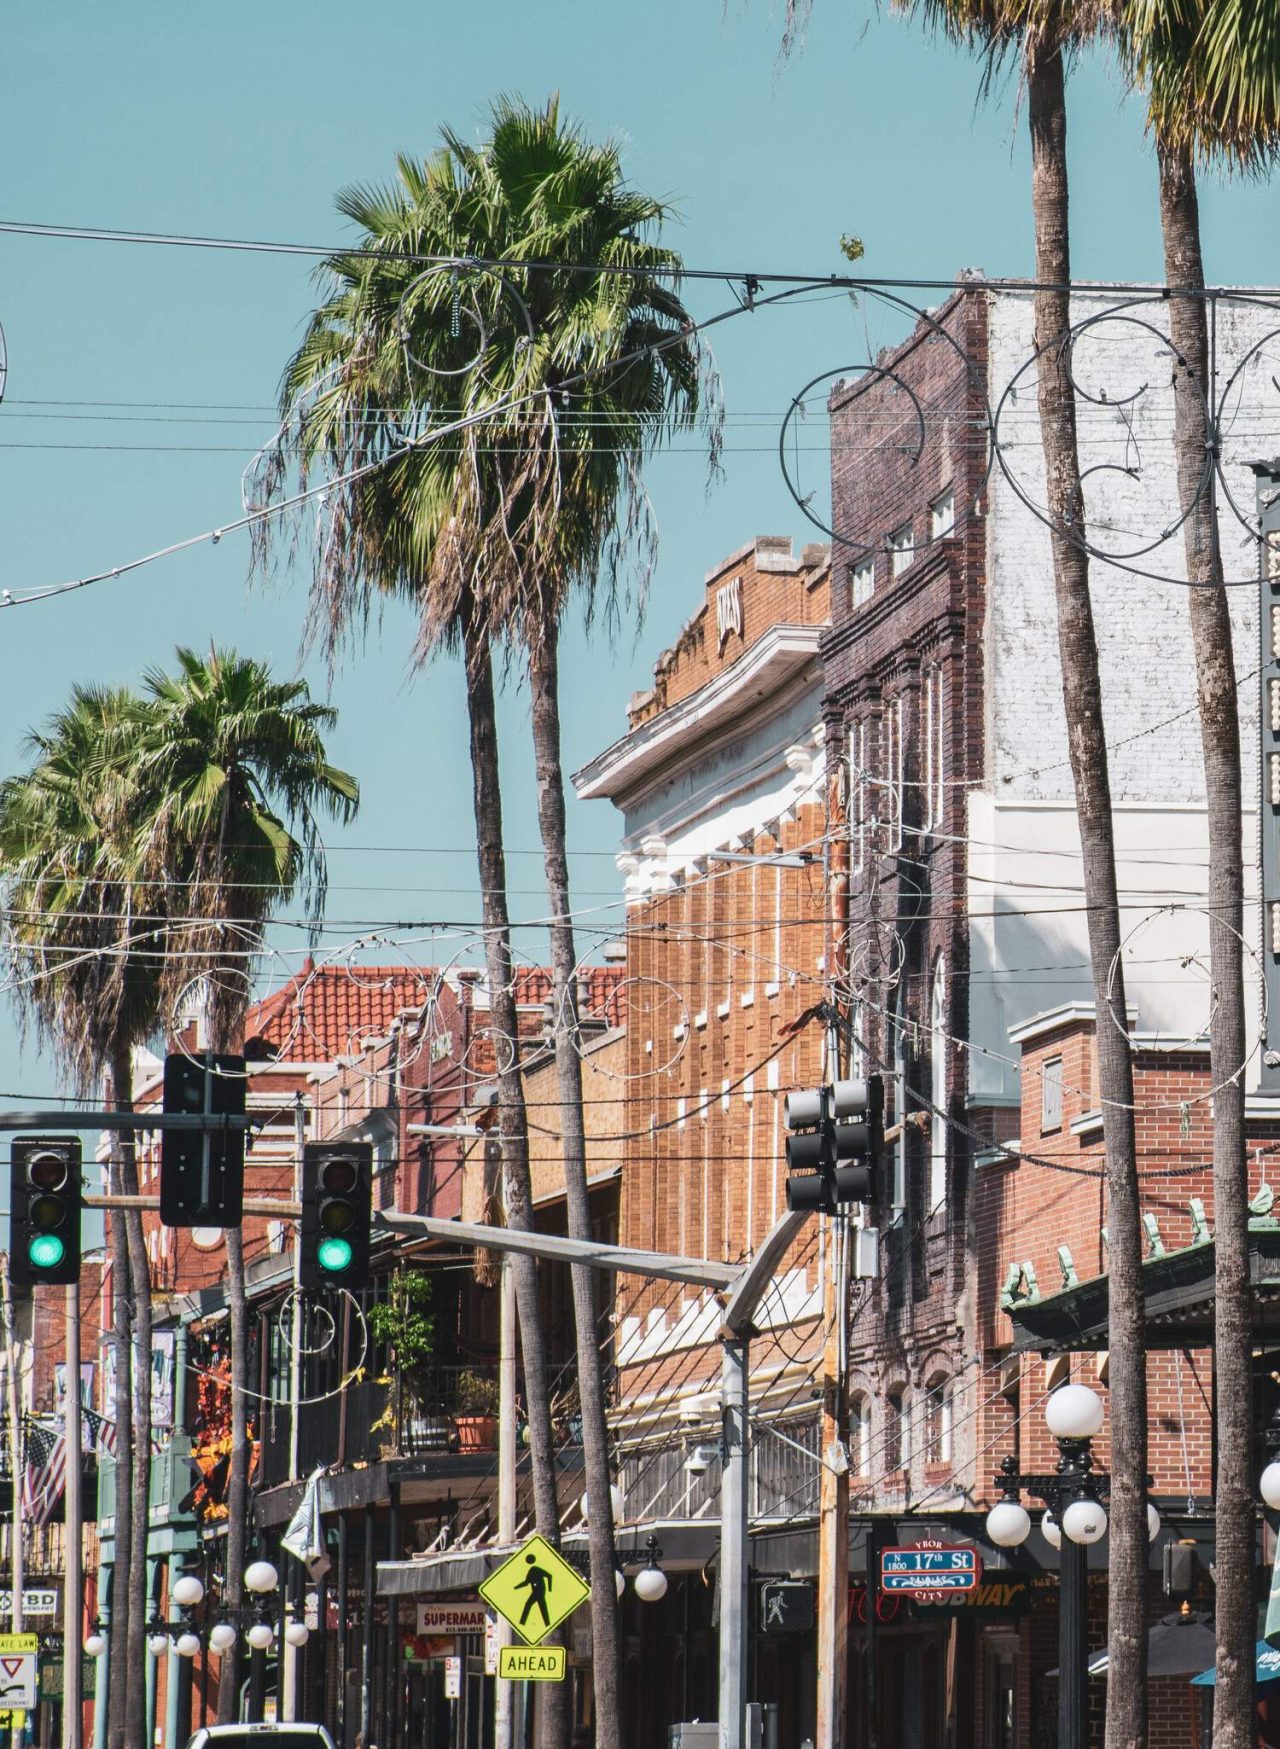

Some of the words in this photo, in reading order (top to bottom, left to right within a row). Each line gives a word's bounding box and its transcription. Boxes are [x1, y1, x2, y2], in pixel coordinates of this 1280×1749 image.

[915, 1540, 943, 1550] YBOR
[888, 1562, 907, 1571] 1800
[894, 1554, 901, 1562] N
[914, 1553, 943, 1570] 17th
[951, 1552, 969, 1569] St
[26, 1594, 54, 1605] BD
[914, 1590, 943, 1601] CITY
[424, 1612, 485, 1626] SUPERMAR
[19, 1639, 35, 1649] LAW
[508, 1656, 557, 1671] AHEAD
